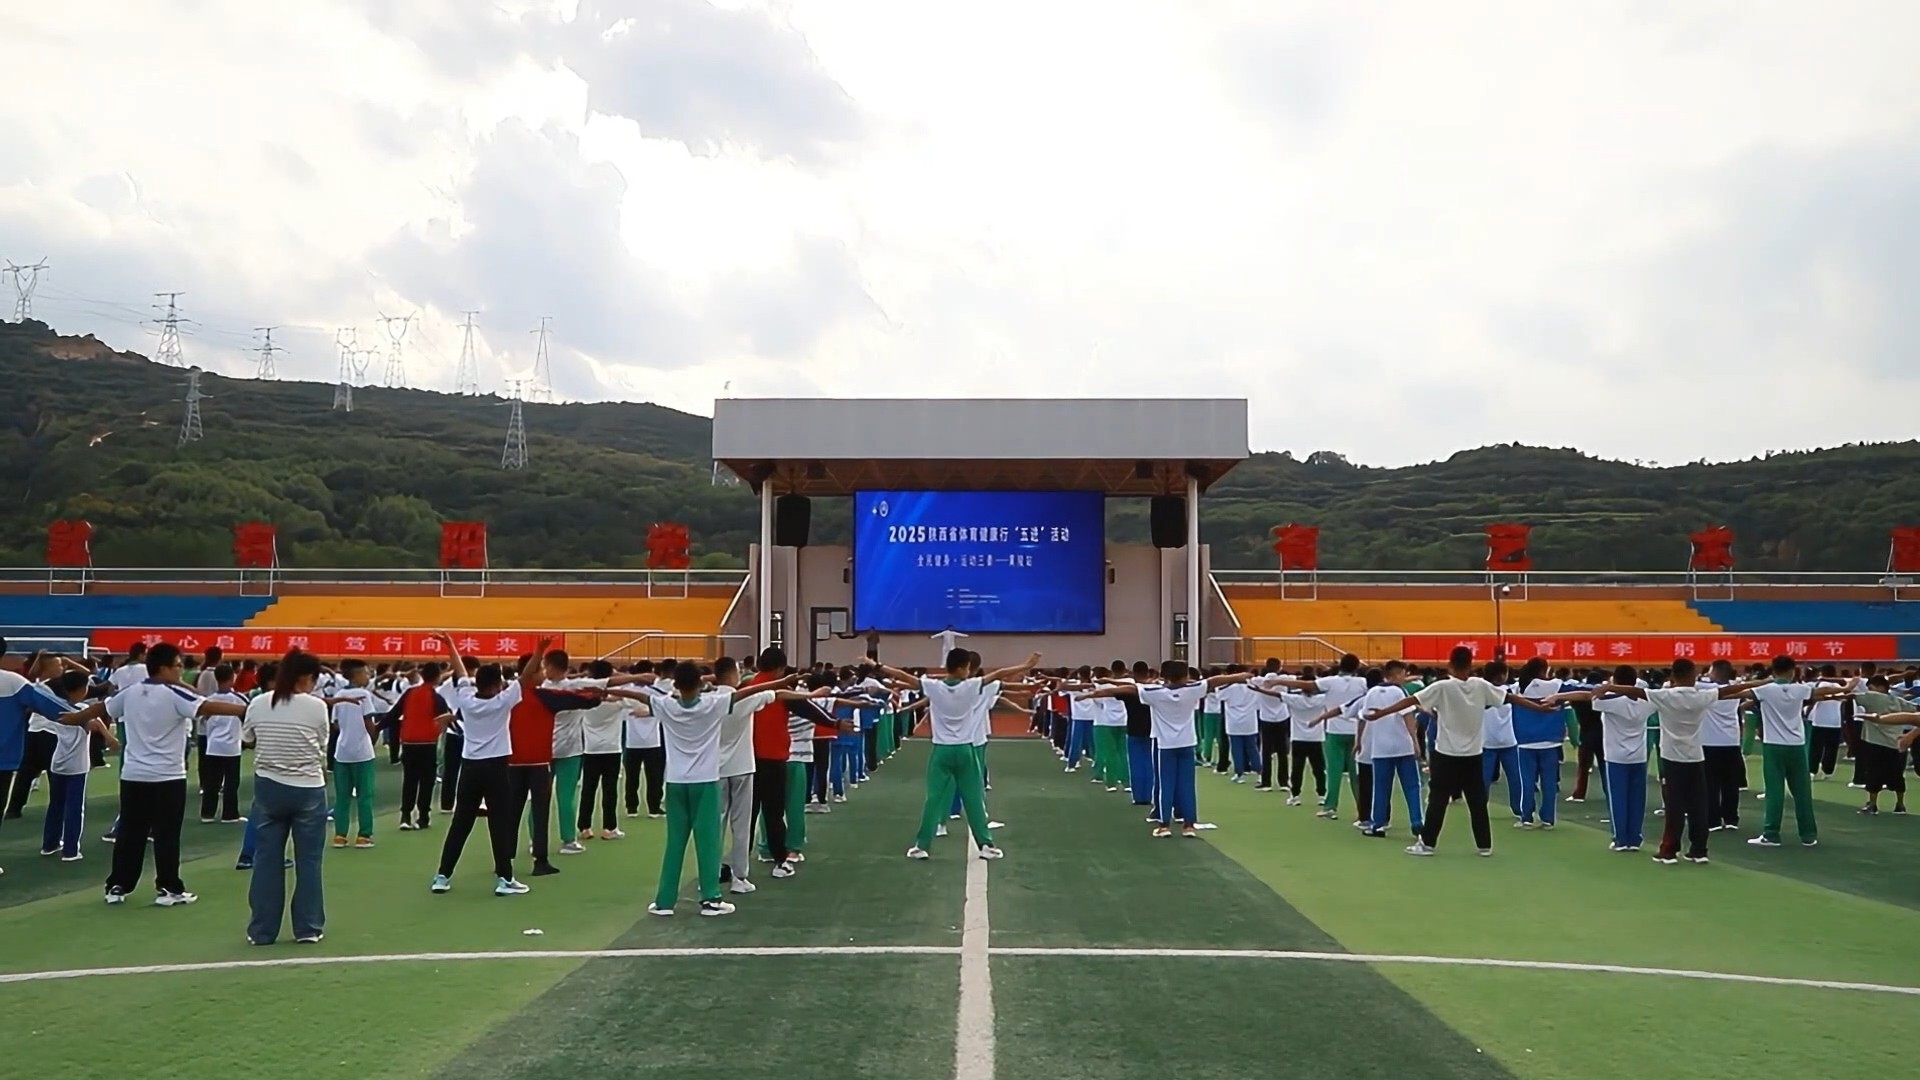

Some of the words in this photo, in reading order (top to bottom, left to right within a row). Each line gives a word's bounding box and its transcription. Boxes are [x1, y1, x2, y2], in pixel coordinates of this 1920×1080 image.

[345, 637, 518, 652] 笃行向未来
[1674, 641, 1846, 656] 躬耕贺师节
